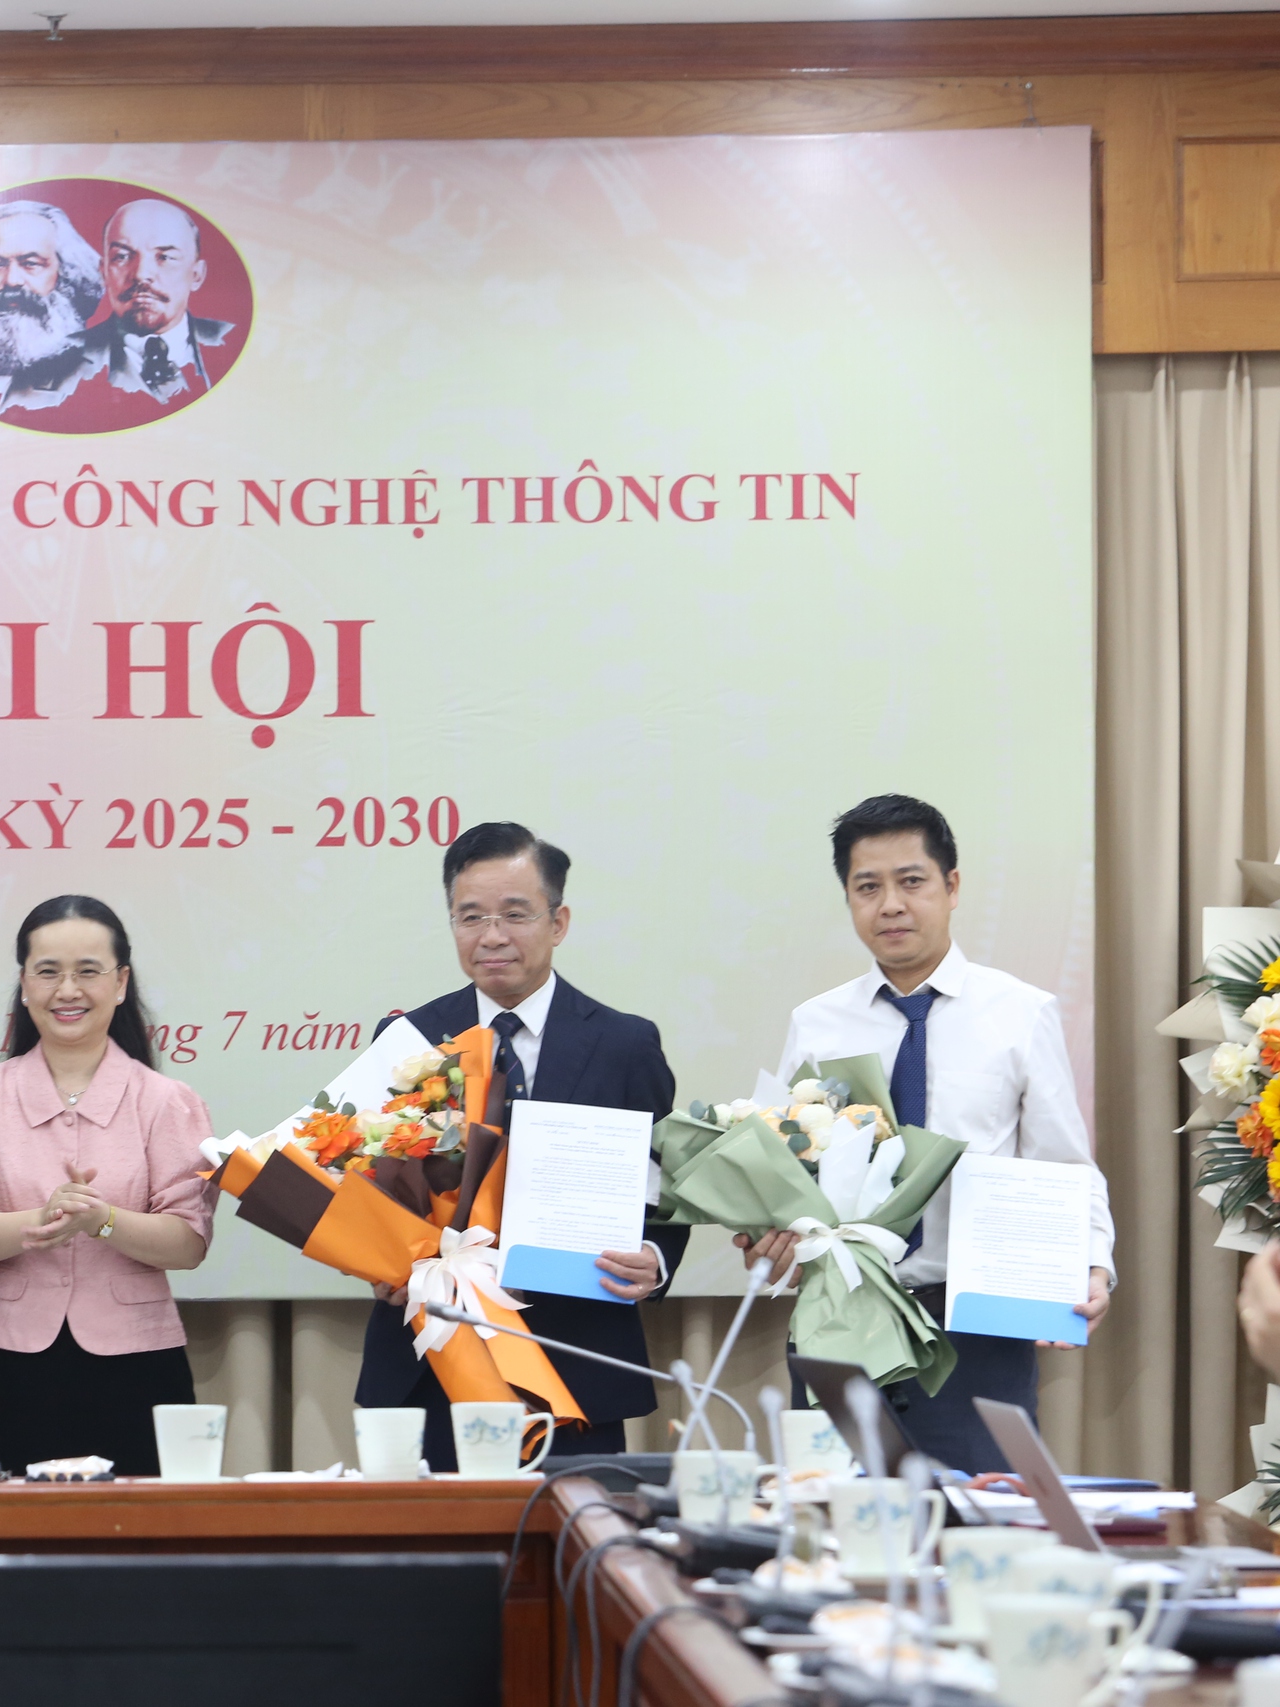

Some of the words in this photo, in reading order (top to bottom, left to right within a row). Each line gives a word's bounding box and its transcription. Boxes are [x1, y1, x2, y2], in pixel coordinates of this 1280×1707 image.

[12, 463, 219, 529] CÔNG
[237, 468, 441, 539] NGHỆ
[461, 458, 720, 523] THÔNG
[739, 472, 862, 521] TIN
[92, 602, 376, 748] HỘI
[105, 798, 251, 850] 2025
[272, 826, 294, 834] -
[315, 795, 460, 848] 2030
[222, 1010, 248, 1052] 7
[261, 1010, 363, 1051] năm
